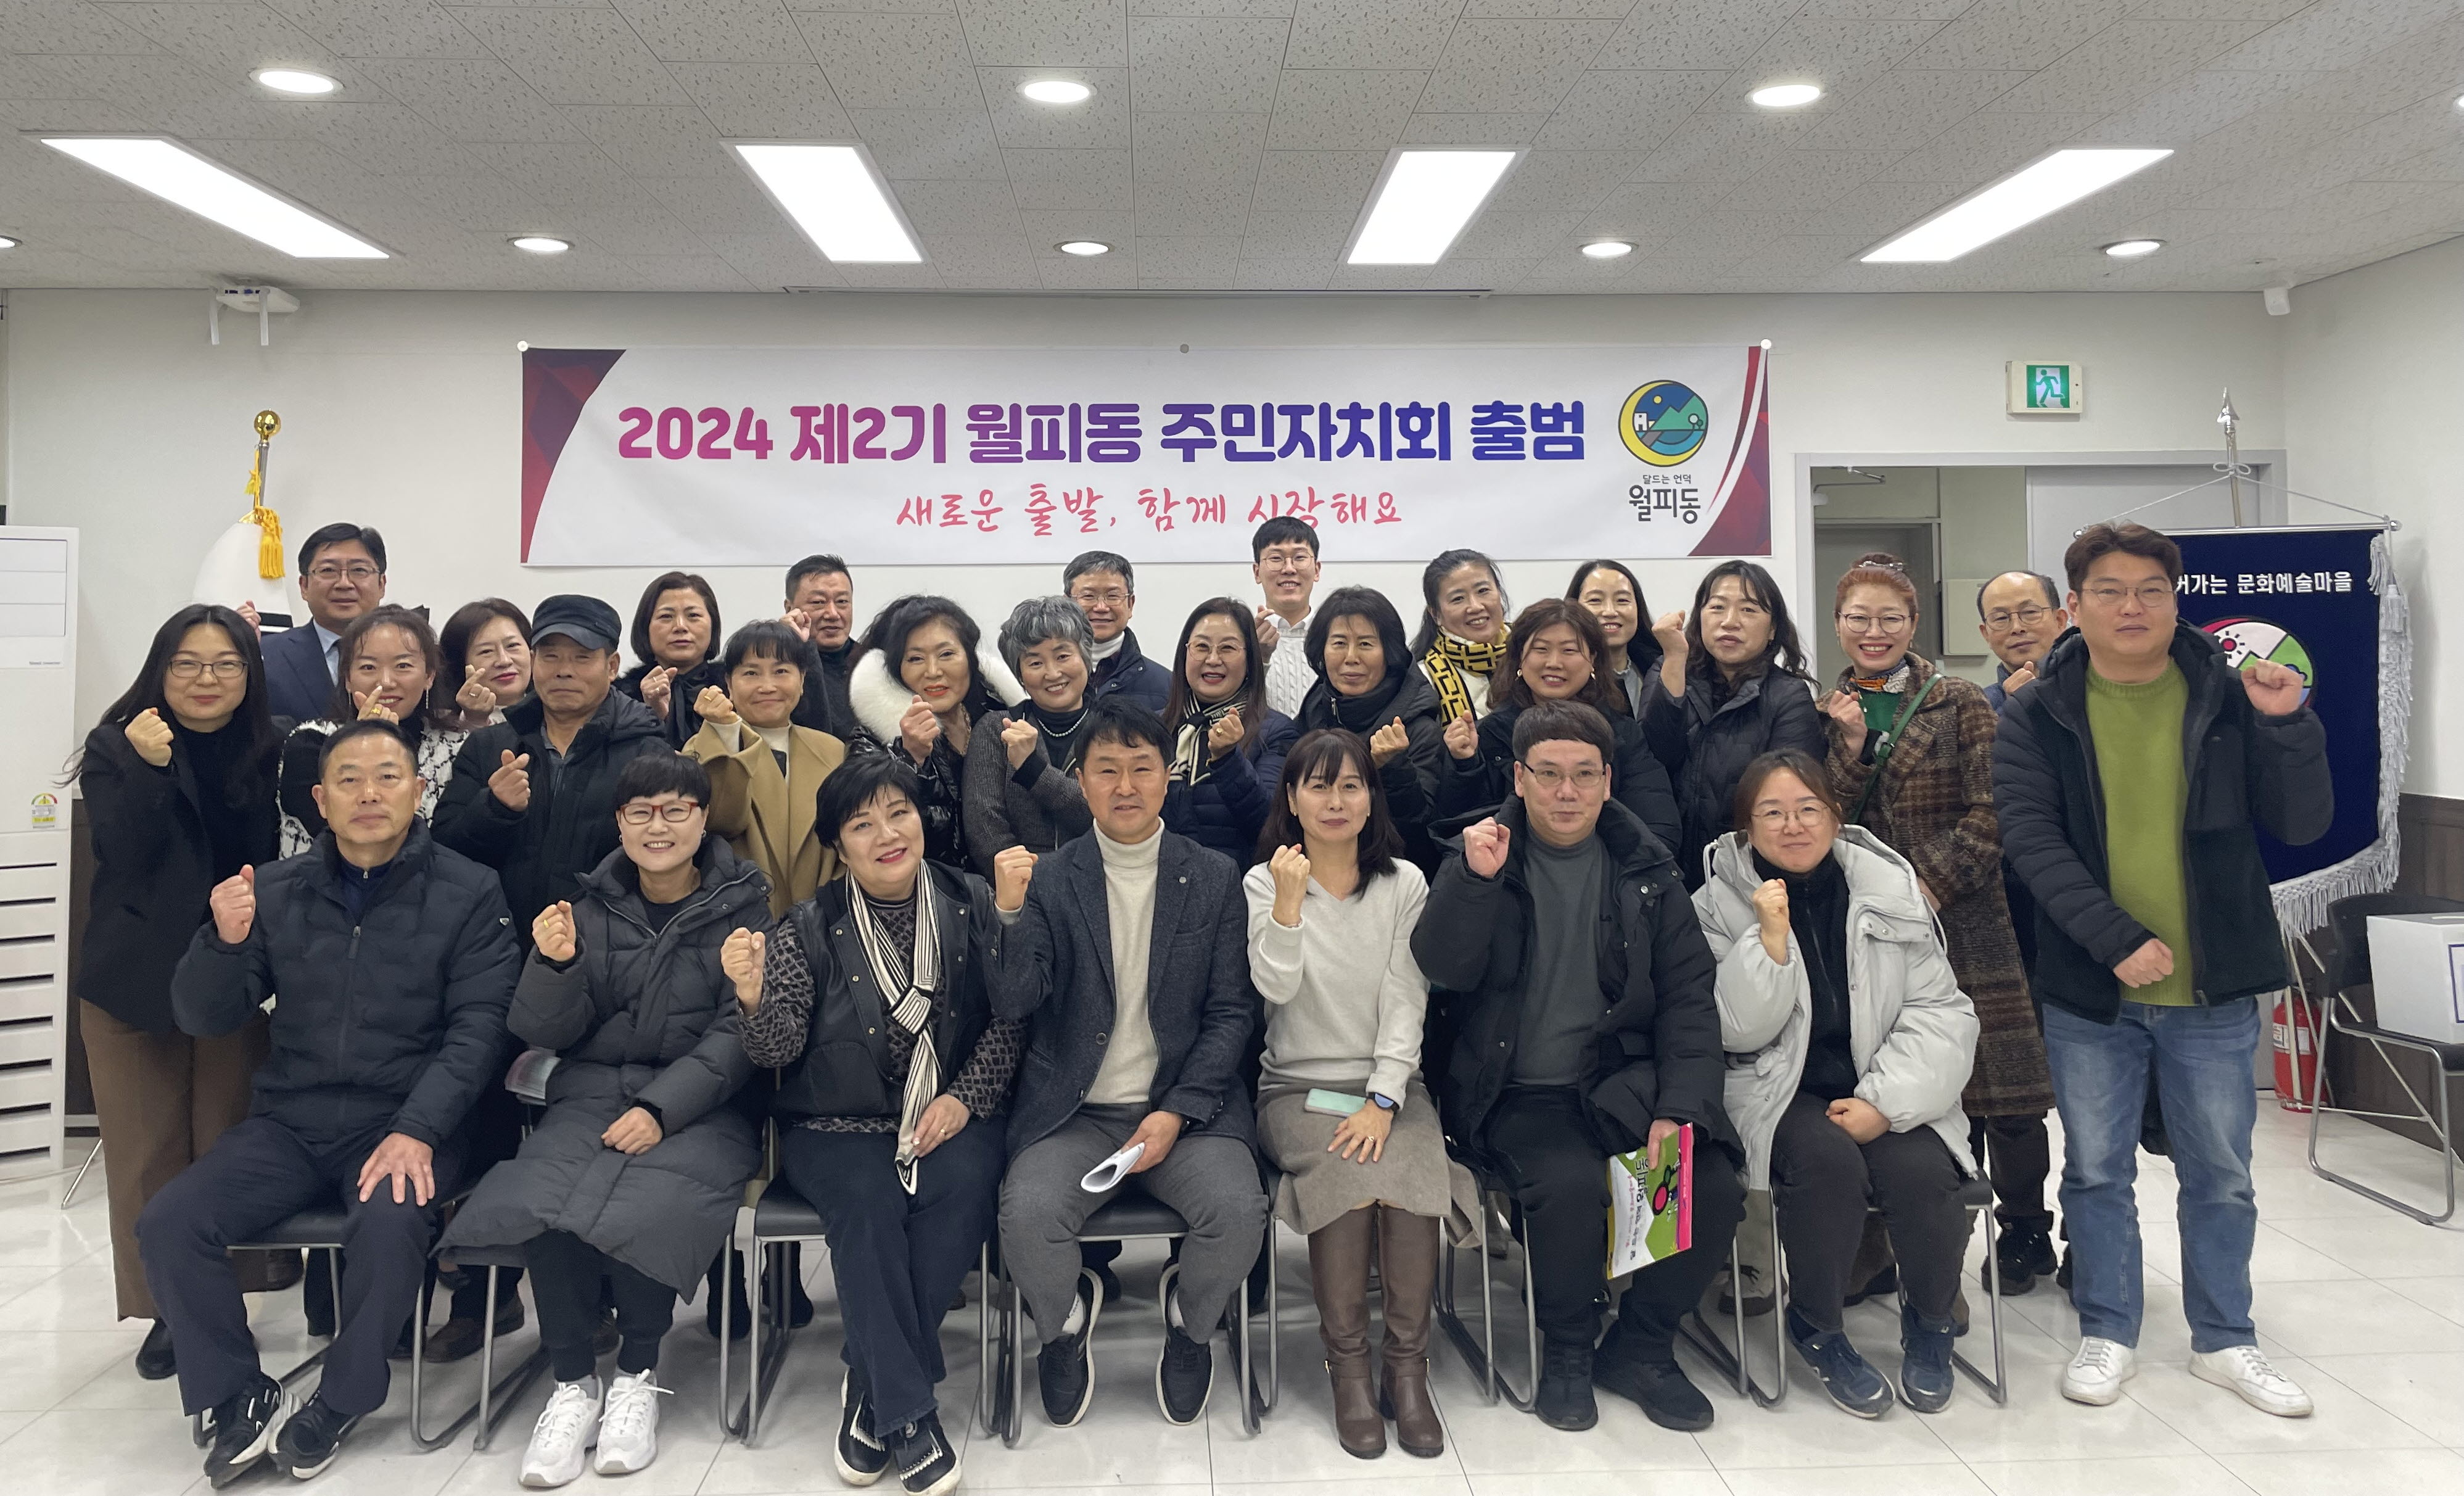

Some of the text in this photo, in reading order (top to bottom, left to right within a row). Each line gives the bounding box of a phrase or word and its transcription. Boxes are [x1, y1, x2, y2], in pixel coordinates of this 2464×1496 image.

[618, 400, 1584, 464] 2024 제2기 월피동 주민자치회 출범
[1673, 473, 1692, 484] 언덕
[896, 489, 1003, 532] 새로운
[1024, 482, 1117, 537] 출발,
[1137, 487, 1227, 534] 함께
[1628, 484, 1701, 524] 월피동
[2236, 571, 2353, 595] 문화예술마을
